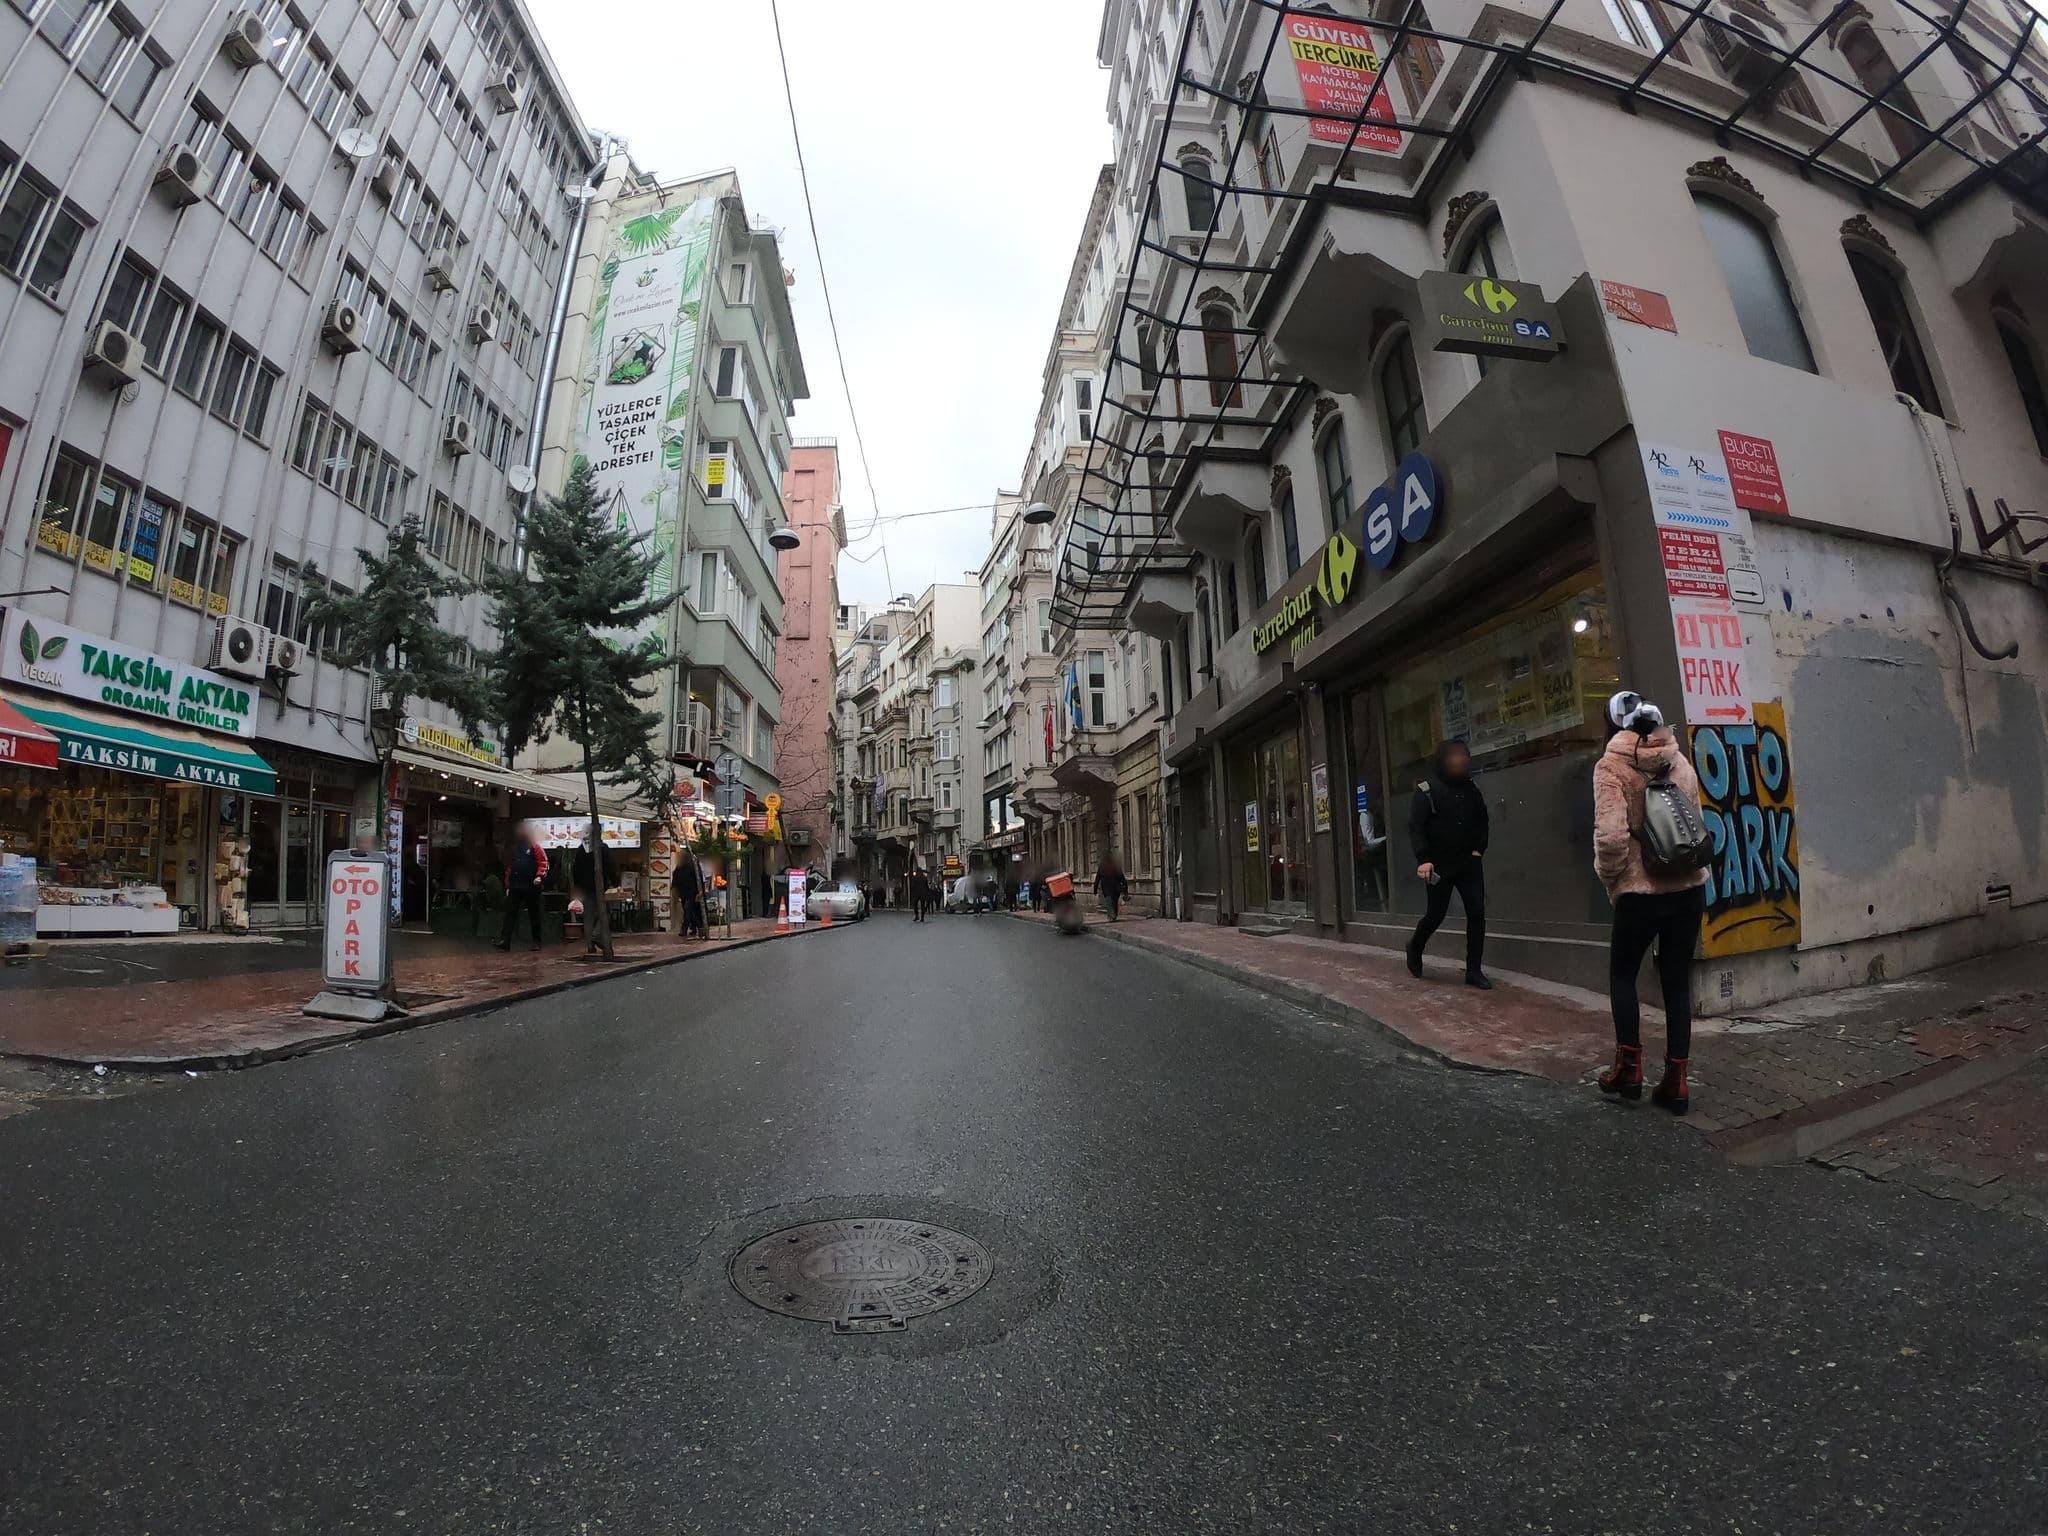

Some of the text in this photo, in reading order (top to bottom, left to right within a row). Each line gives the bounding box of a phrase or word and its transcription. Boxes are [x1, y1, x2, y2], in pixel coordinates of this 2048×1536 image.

[1292, 22, 1366, 49] GÜVEN
[1293, 41, 1378, 72] TERCÜME
[1321, 66, 1360, 80] NOTER
[1441, 314, 1509, 332] Carrefour
[597, 395, 662, 420] YÜZLERCE
[599, 410, 656, 430] TASARIM
[605, 425, 647, 447] ÇİÇEK
[612, 441, 636, 455] TEK
[592, 451, 654, 473] ADRESTE!
[1729, 457, 1777, 477] TERCÜME
[1367, 472, 1432, 555] SA
[1665, 545, 1719, 558] TERZİ
[1693, 535, 1716, 545] DERİ
[1251, 585, 1312, 656] Carrefour
[1675, 613, 1743, 648] OTO
[1291, 616, 1316, 658] mini
[20, 664, 63, 688] VEGAN
[81, 644, 250, 715] TAKSİM AKTAR
[1681, 657, 1742, 697] PARK
[101, 686, 240, 732] ORGANİK ÜRÜNLER
[67, 741, 241, 787] TAKSİM AKTAR
[1694, 725, 1784, 801] OTO
[1704, 804, 1798, 907] PARK
[332, 879, 379, 896] OTO
[344, 898, 361, 976] PARK
